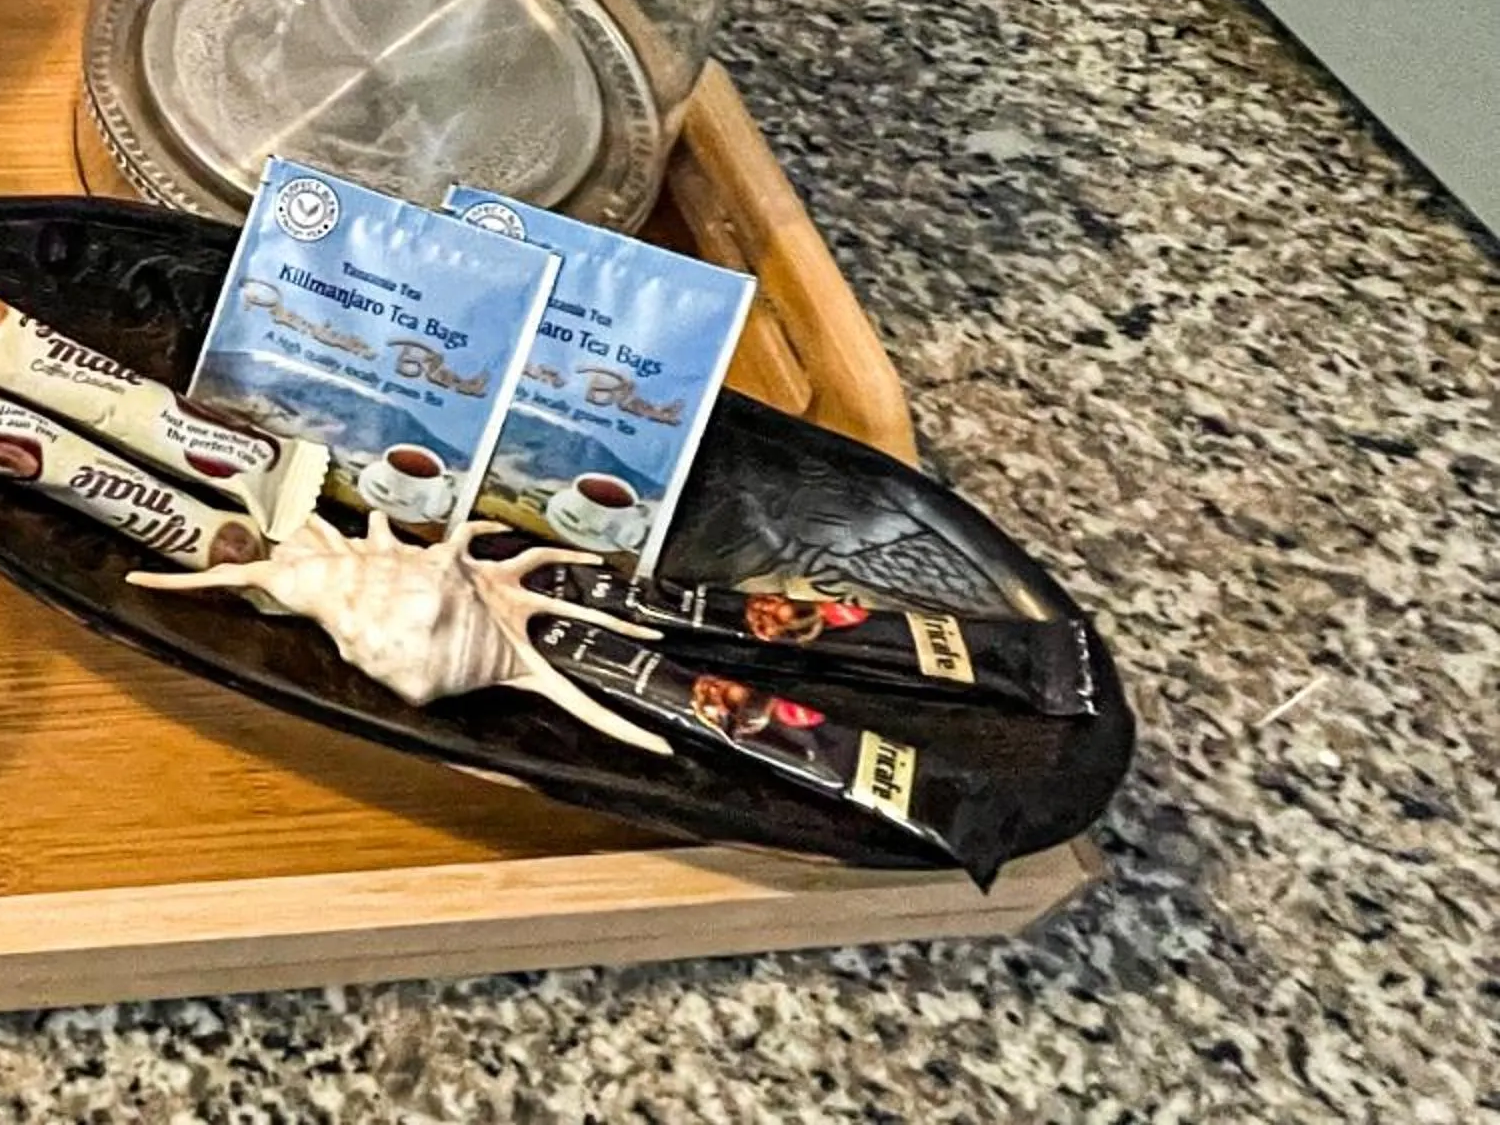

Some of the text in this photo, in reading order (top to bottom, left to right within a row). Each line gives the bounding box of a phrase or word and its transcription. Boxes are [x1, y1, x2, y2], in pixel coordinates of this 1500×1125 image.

[278, 263, 469, 350] Kilimanjaro Tea Bags
[400, 283, 423, 302] Tea
[590, 308, 612, 327] Tea
[579, 330, 610, 356] Tea
[616, 344, 664, 377] Bags
[70, 466, 174, 515] mate
